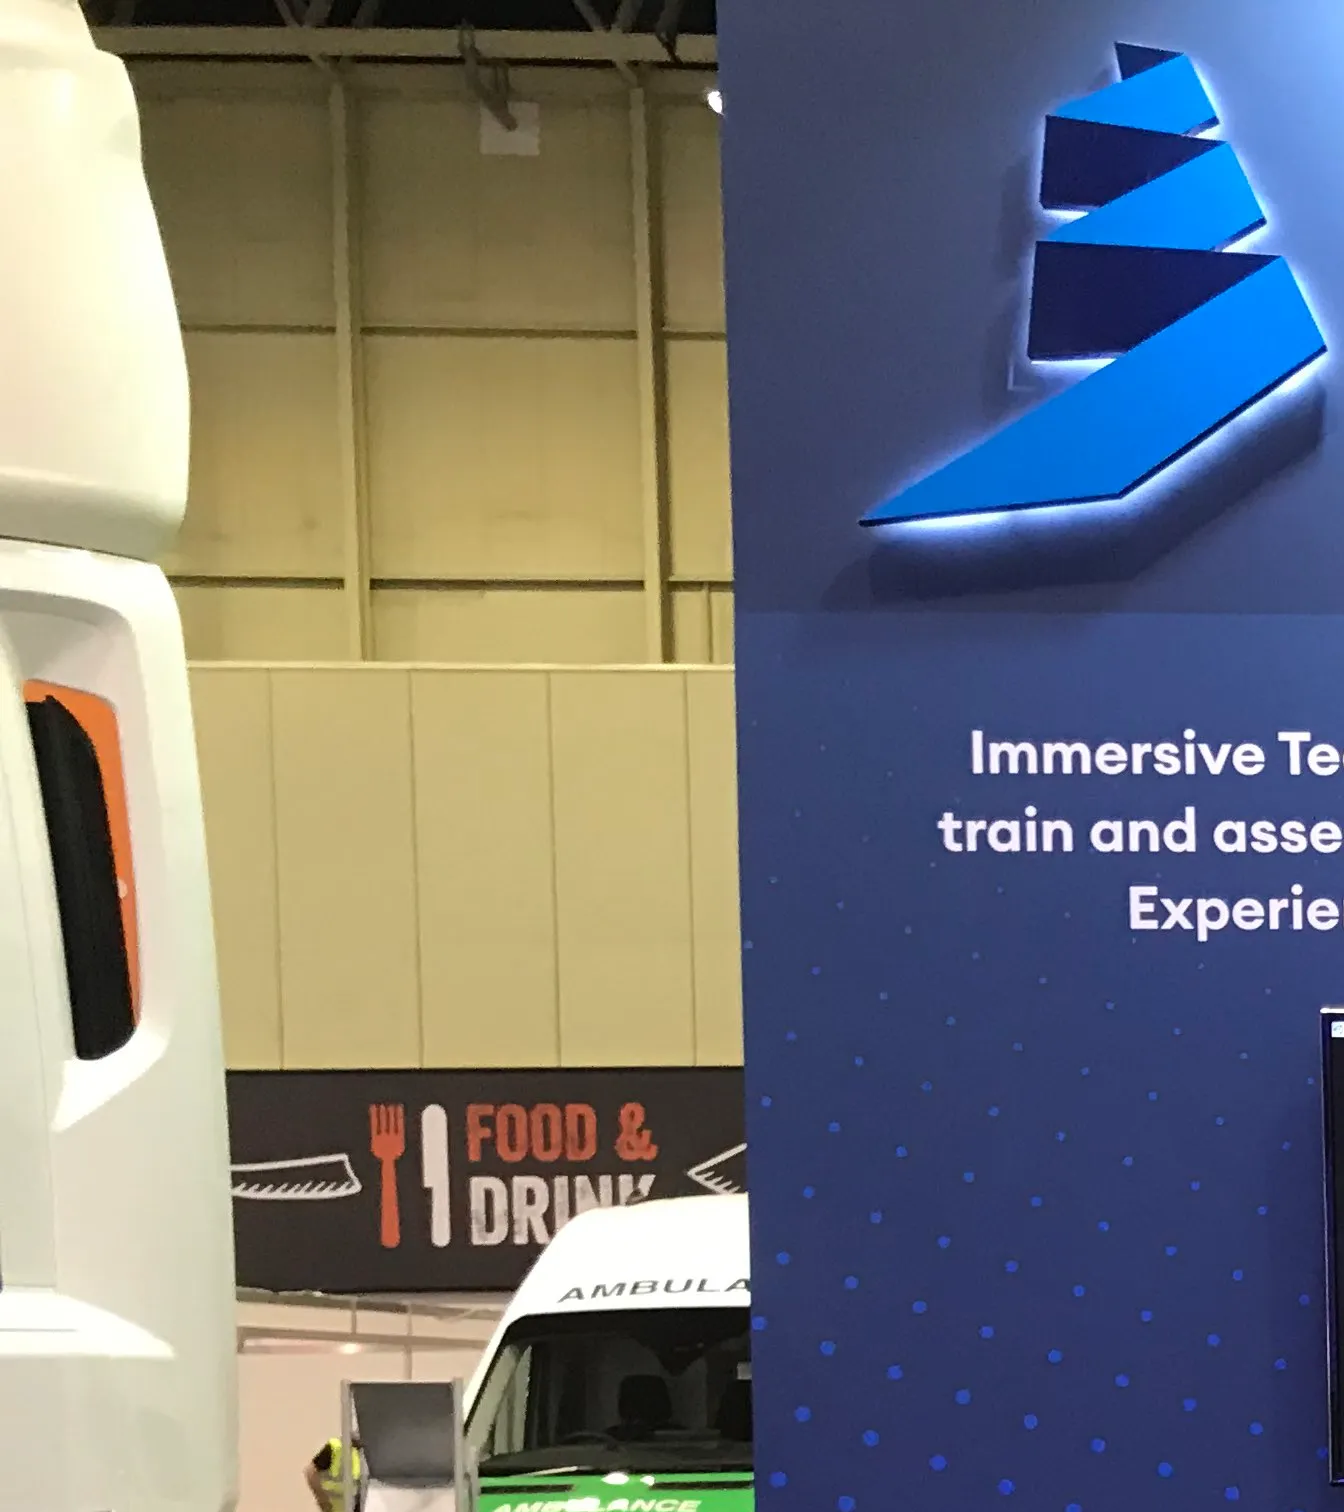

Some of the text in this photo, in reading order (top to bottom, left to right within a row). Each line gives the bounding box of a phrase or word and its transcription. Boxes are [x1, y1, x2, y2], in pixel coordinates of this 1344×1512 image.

[972, 728, 1265, 775] Immersive
[938, 805, 1073, 852] train
[1090, 806, 1196, 853] and
[466, 1102, 659, 1163] FOOD &
[557, 1278, 750, 1303] AMBULA
